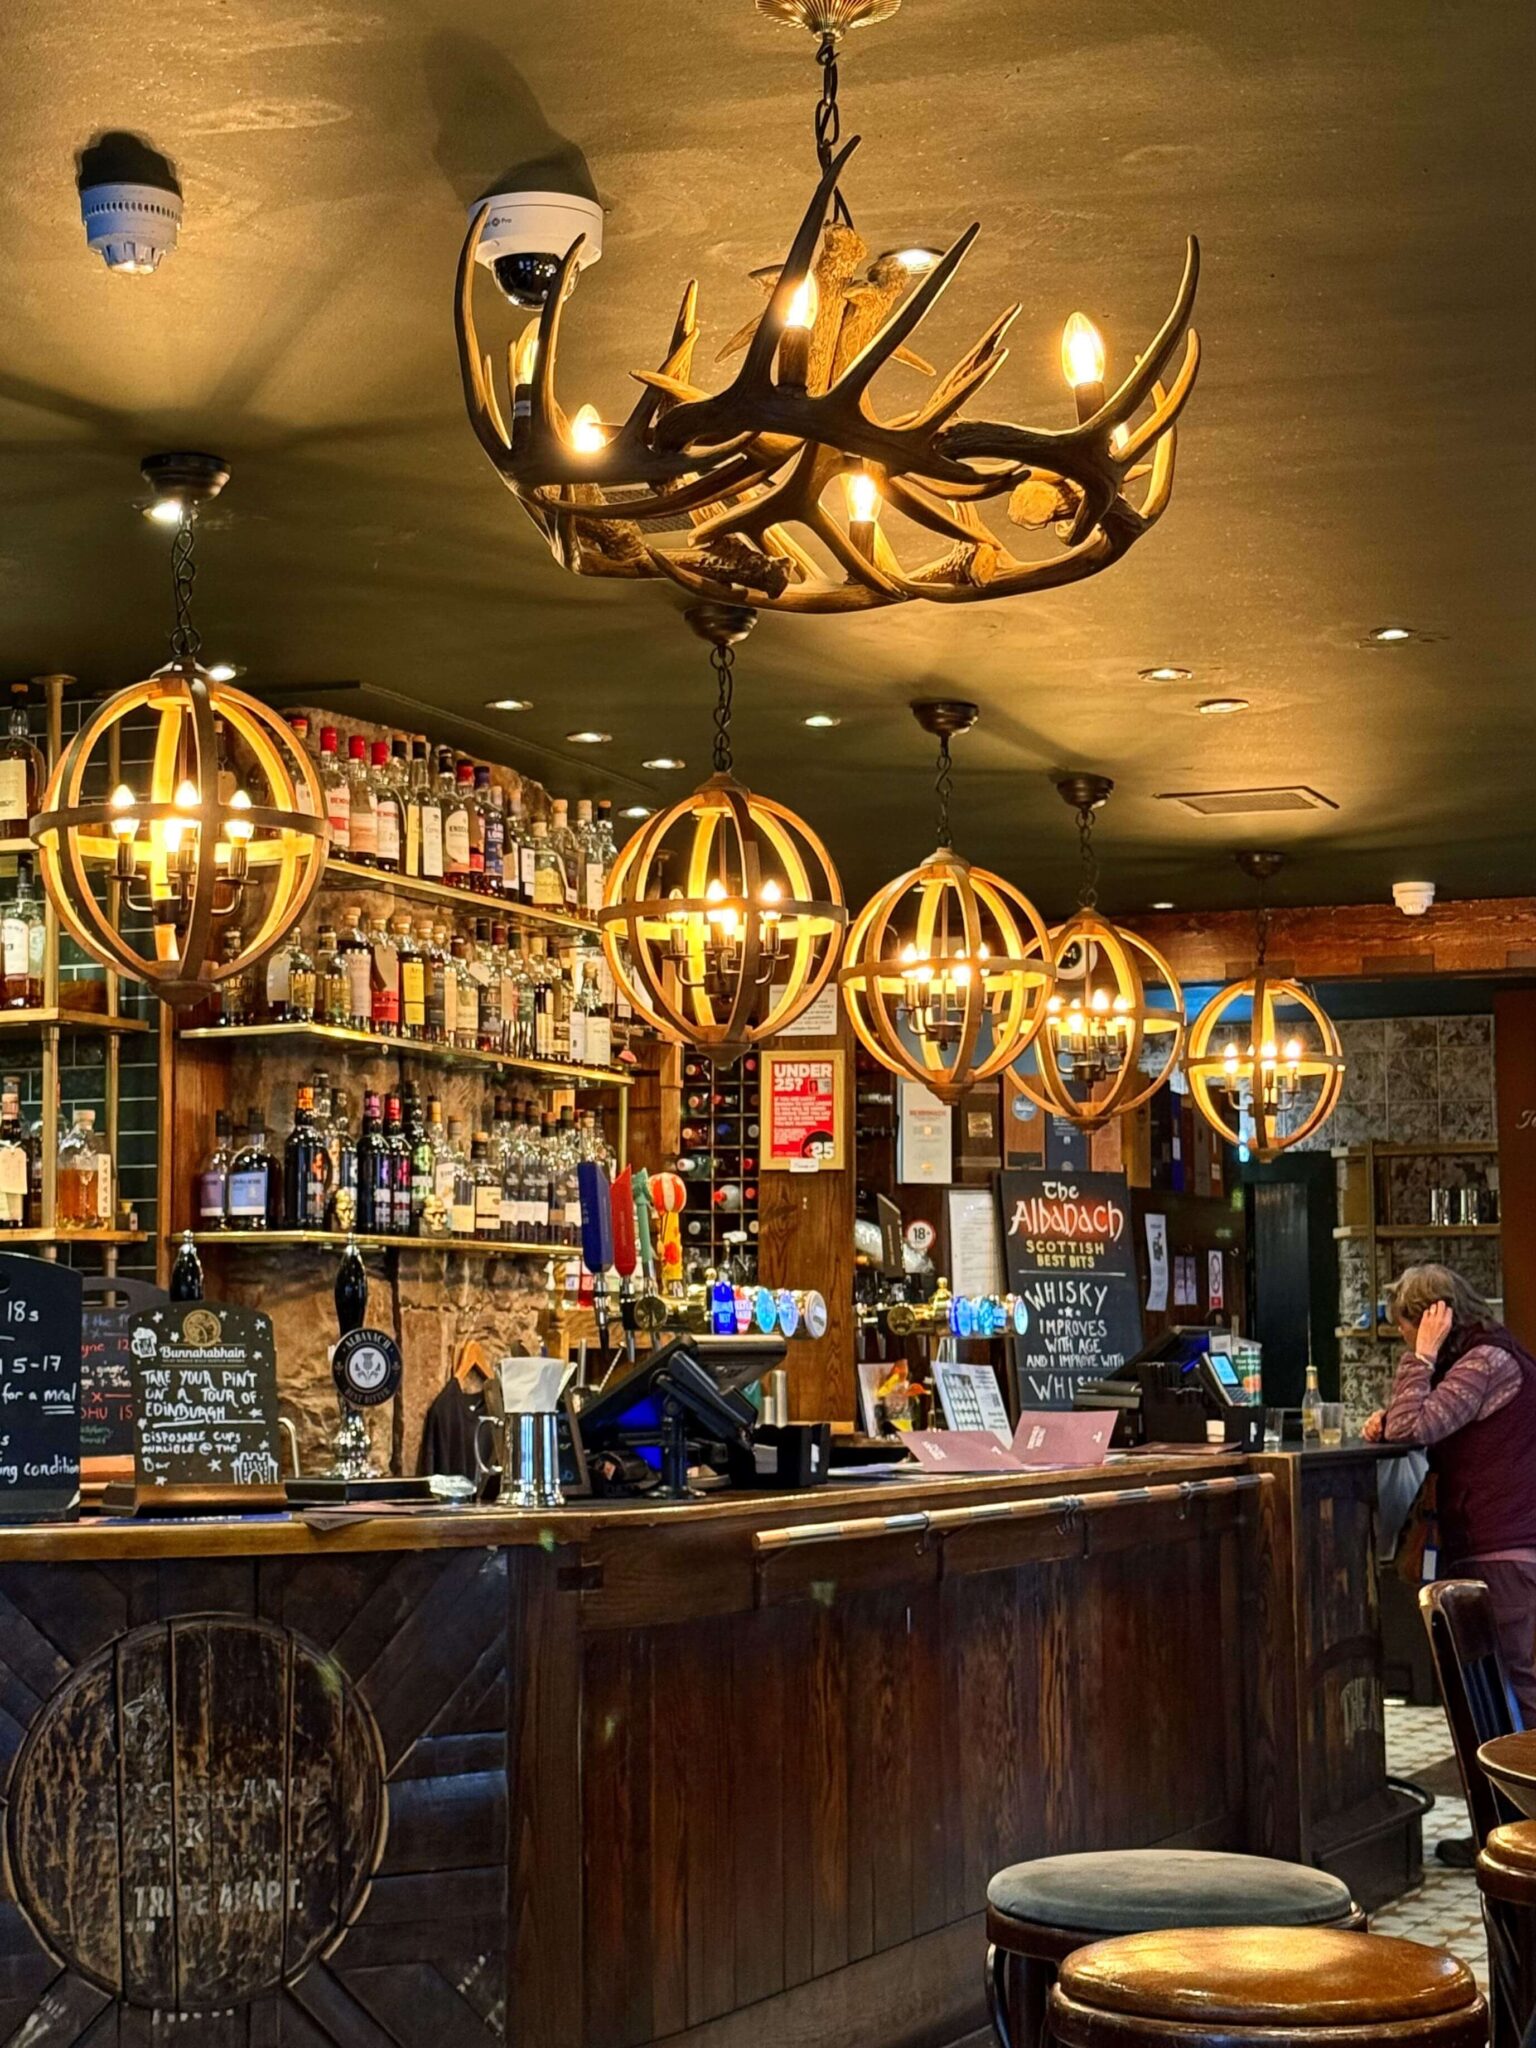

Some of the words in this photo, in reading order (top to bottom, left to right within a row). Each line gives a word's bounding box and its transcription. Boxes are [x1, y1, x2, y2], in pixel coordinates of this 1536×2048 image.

[774, 1063, 832, 1078] UNDER
[774, 1078, 803, 1092] 25?
[811, 1141, 834, 1159] 25
[1042, 1181, 1080, 1201] The
[1007, 1198, 1124, 1242] Albanach
[1026, 1239, 1105, 1255] SCOTTISH
[1036, 1254, 1067, 1268] BEST
[1069, 1255, 1095, 1269] BITS
[1024, 1280, 1109, 1316] WHISKY
[7, 1300, 39, 1322] 18s
[1039, 1318, 1108, 1338] IMPROVES
[159, 1345, 247, 1359] Bunnahabhain
[1044, 1338, 1074, 1355] WITH
[1078, 1338, 1102, 1355] AGE
[12, 1354, 62, 1375] 5-17
[1026, 1354, 1048, 1368] AND
[1059, 1354, 1099, 1368] IMPROVE
[1101, 1354, 1125, 1367] WITH
[140, 1369, 171, 1386] TAKE
[180, 1370, 216, 1392] YOUR
[2, 1382, 24, 1405] for
[28, 1393, 38, 1401] a
[44, 1381, 77, 1402] meal
[145, 1389, 168, 1401] ON
[177, 1389, 191, 1402] A
[201, 1389, 239, 1408] TOUR
[241, 1389, 257, 1404] OF
[145, 1404, 226, 1421] EDINBURGH
[142, 1430, 206, 1444] DISPOSABLE
[213, 1430, 241, 1443] CUPS
[199, 1442, 213, 1455] @
[215, 1443, 238, 1454] THE
